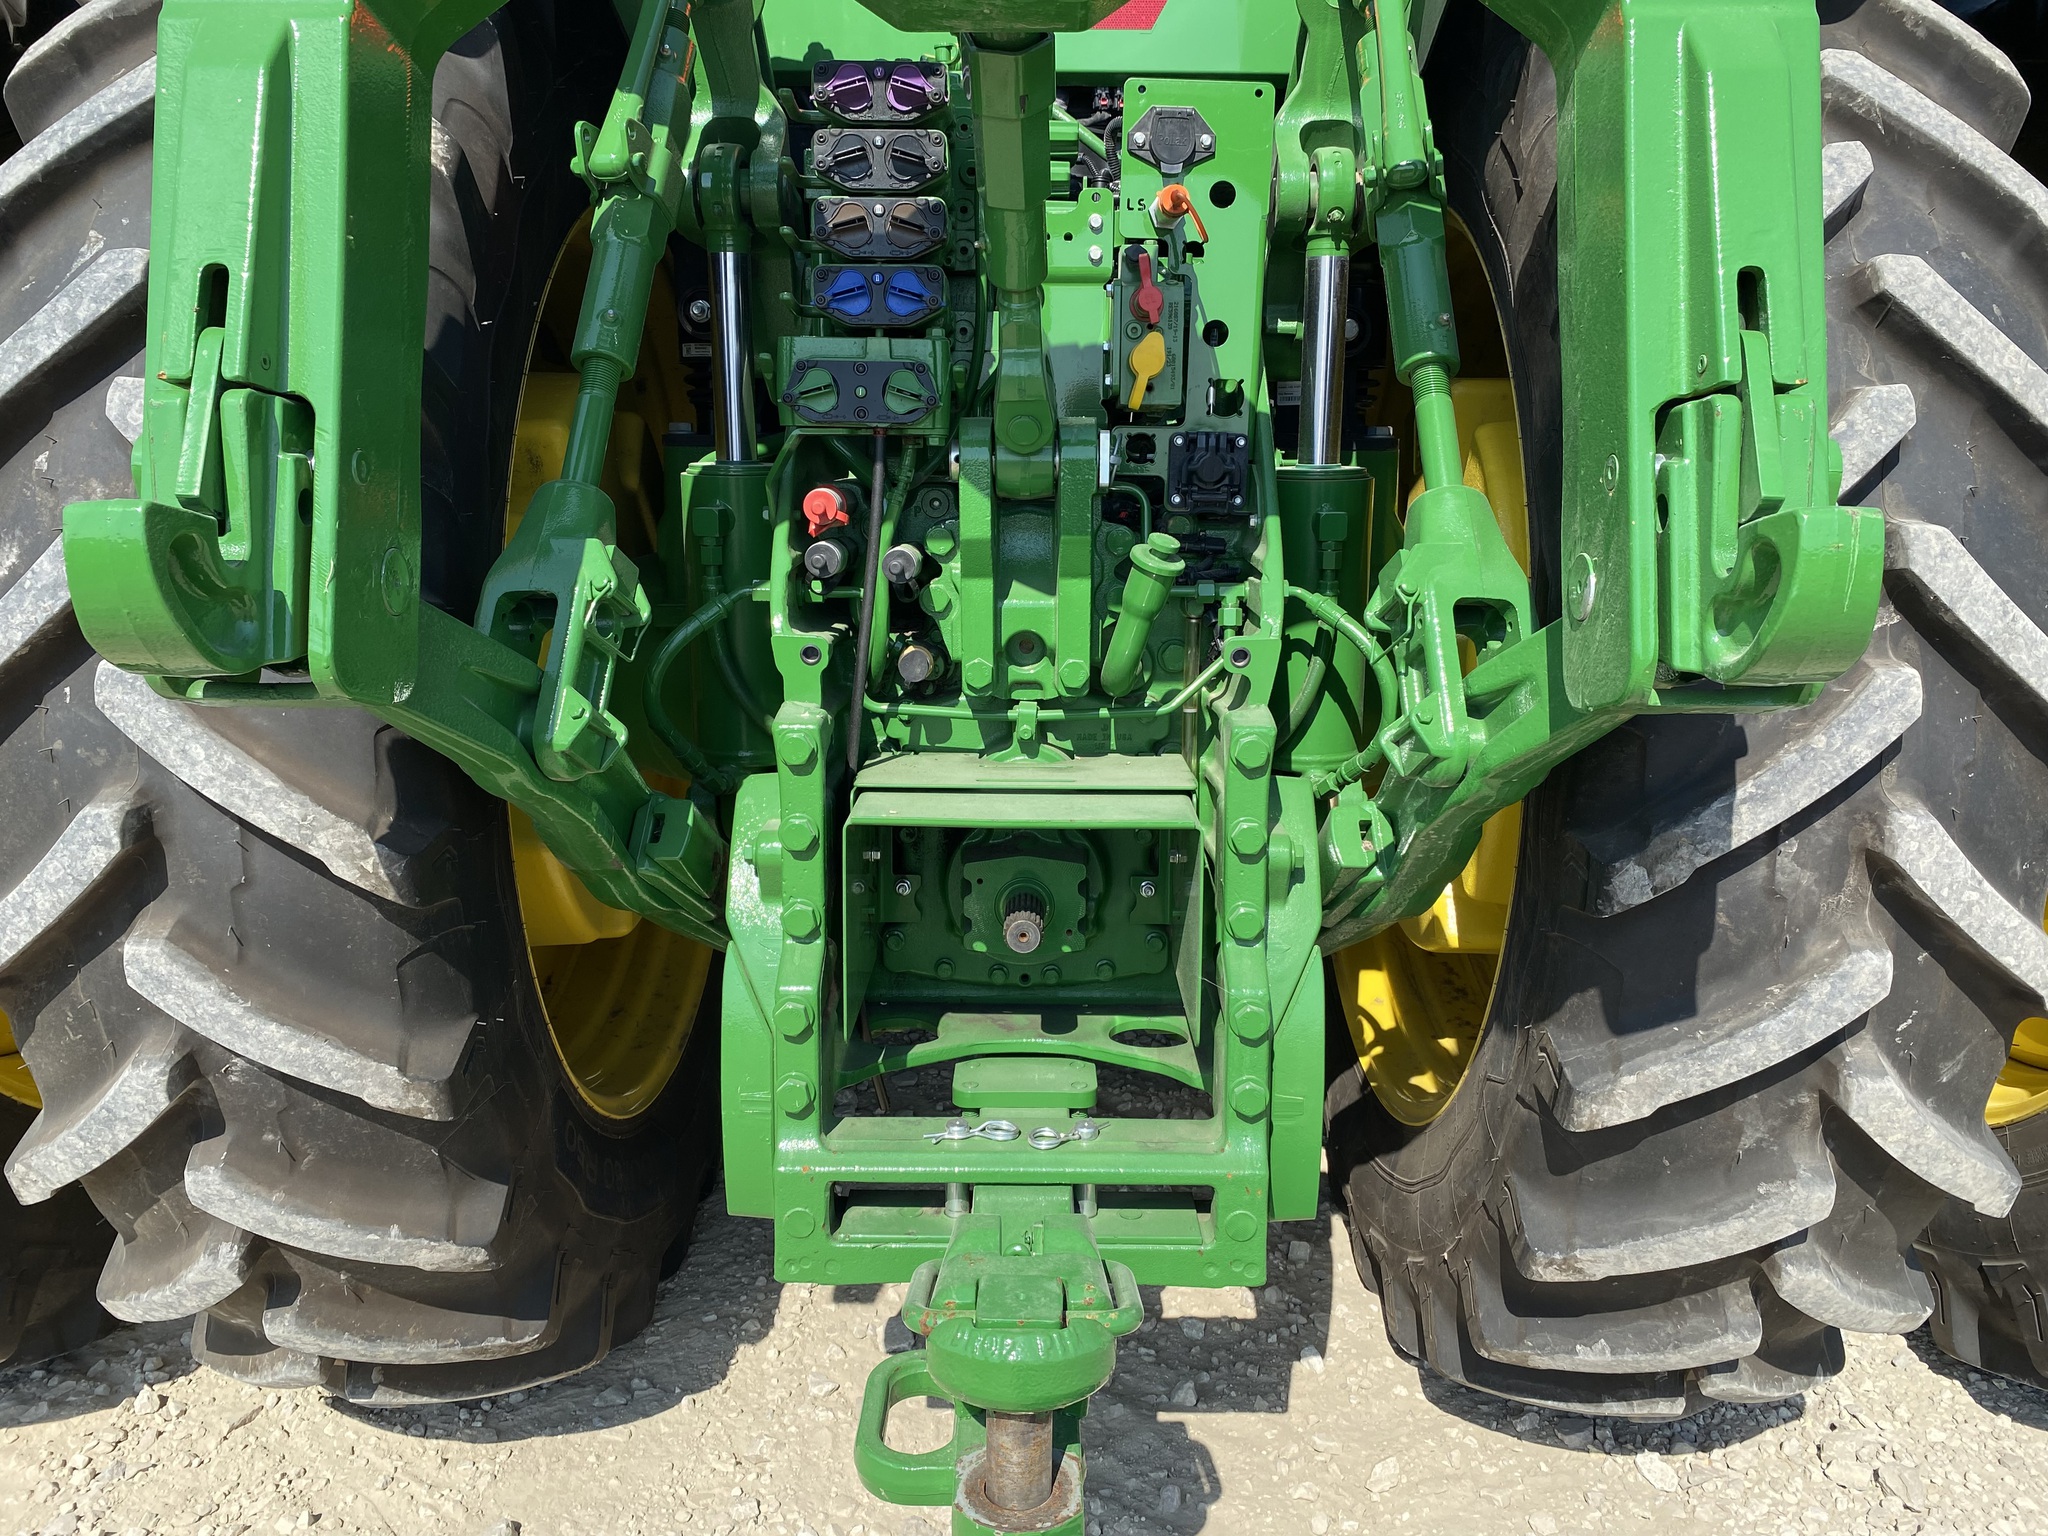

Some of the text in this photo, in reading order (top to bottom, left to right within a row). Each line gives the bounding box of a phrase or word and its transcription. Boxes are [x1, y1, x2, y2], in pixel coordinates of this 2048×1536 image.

[1157, 134, 1188, 147] Pollak
[1126, 197, 1146, 211] LS
[1076, 733, 1097, 741] MADE
[1117, 733, 1133, 741] USA
